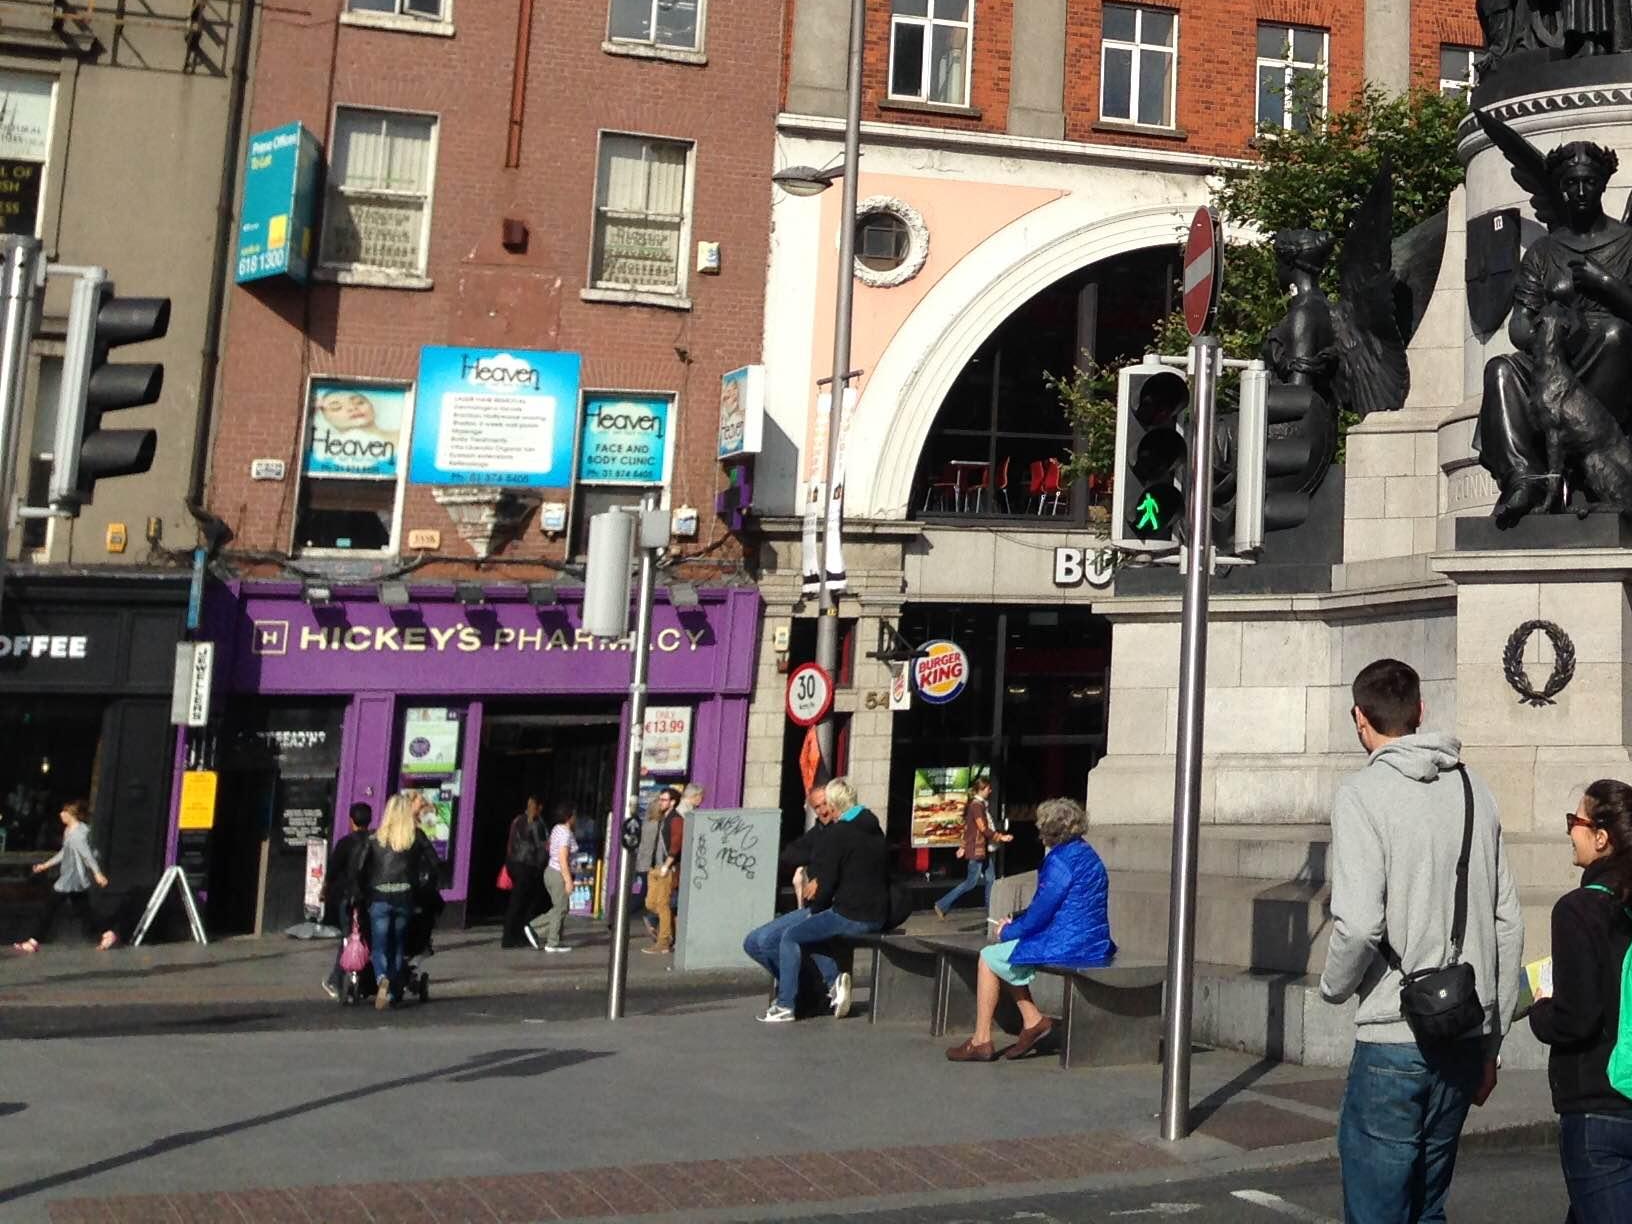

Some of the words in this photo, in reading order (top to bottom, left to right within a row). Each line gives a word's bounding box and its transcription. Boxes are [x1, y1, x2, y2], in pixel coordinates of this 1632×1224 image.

[239, 254, 257, 275] 618
[259, 248, 284, 270] 1300
[460, 353, 540, 391] Heaven
[584, 405, 664, 439] Heaven
[311, 426, 395, 466] Heaven
[595, 444, 623, 453] FACE
[626, 444, 649, 454] AND
[587, 456, 616, 465] BODY
[620, 456, 656, 466] CLINIC
[262, 630, 278, 645] H
[300, 624, 482, 651] HICKEY'S
[494, 628, 705, 652] PHARMCY
[918, 652, 961, 674] BURGER
[798, 675, 815, 701] 30
[919, 663, 963, 690] KING
[645, 720, 684, 733] €13.99
